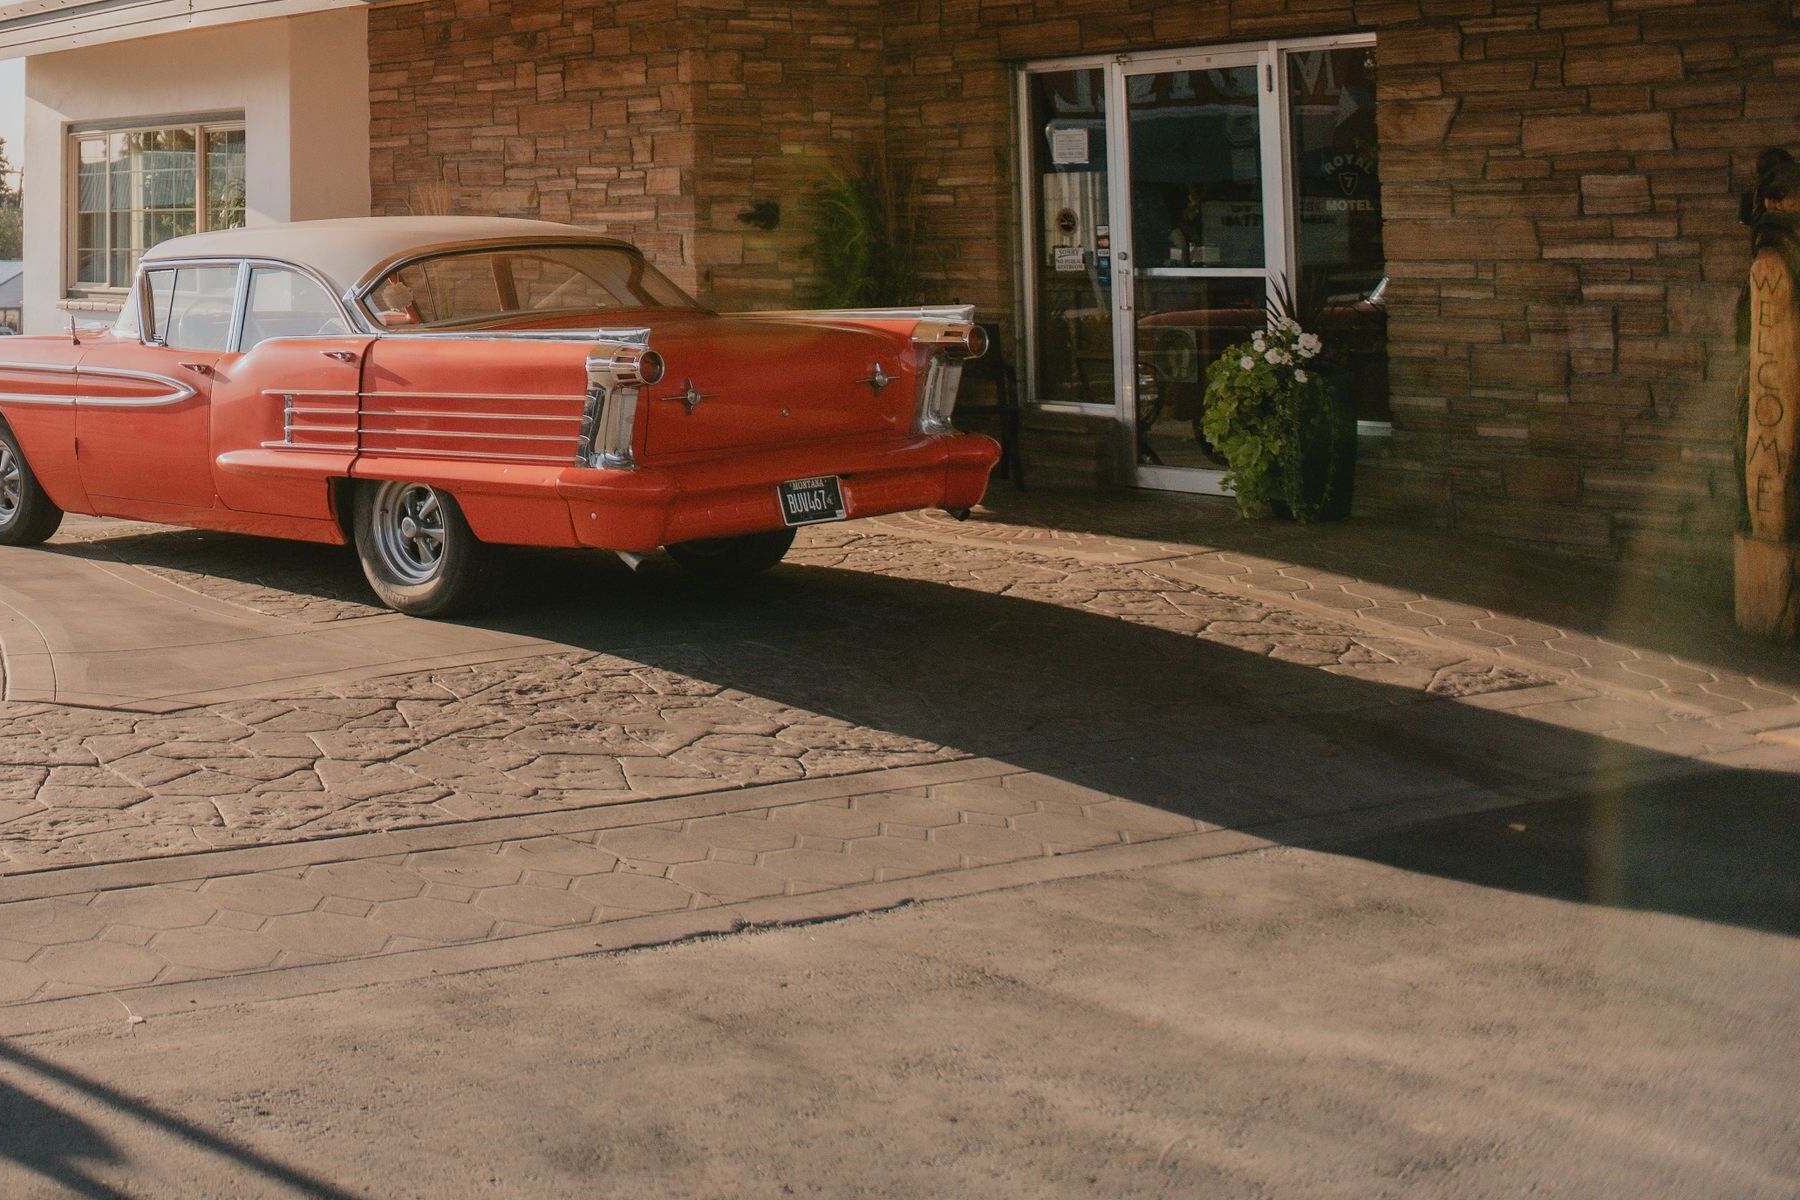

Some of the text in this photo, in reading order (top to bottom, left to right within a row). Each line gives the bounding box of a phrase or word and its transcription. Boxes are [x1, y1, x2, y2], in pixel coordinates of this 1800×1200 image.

[1324, 153, 1372, 175] ROYAL
[1343, 176, 1353, 188] 7
[1325, 199, 1374, 211] MOTEL
[1749, 271, 1784, 513] WELCOME
[792, 479, 825, 491] MONTANA
[786, 489, 827, 514] BUV467
